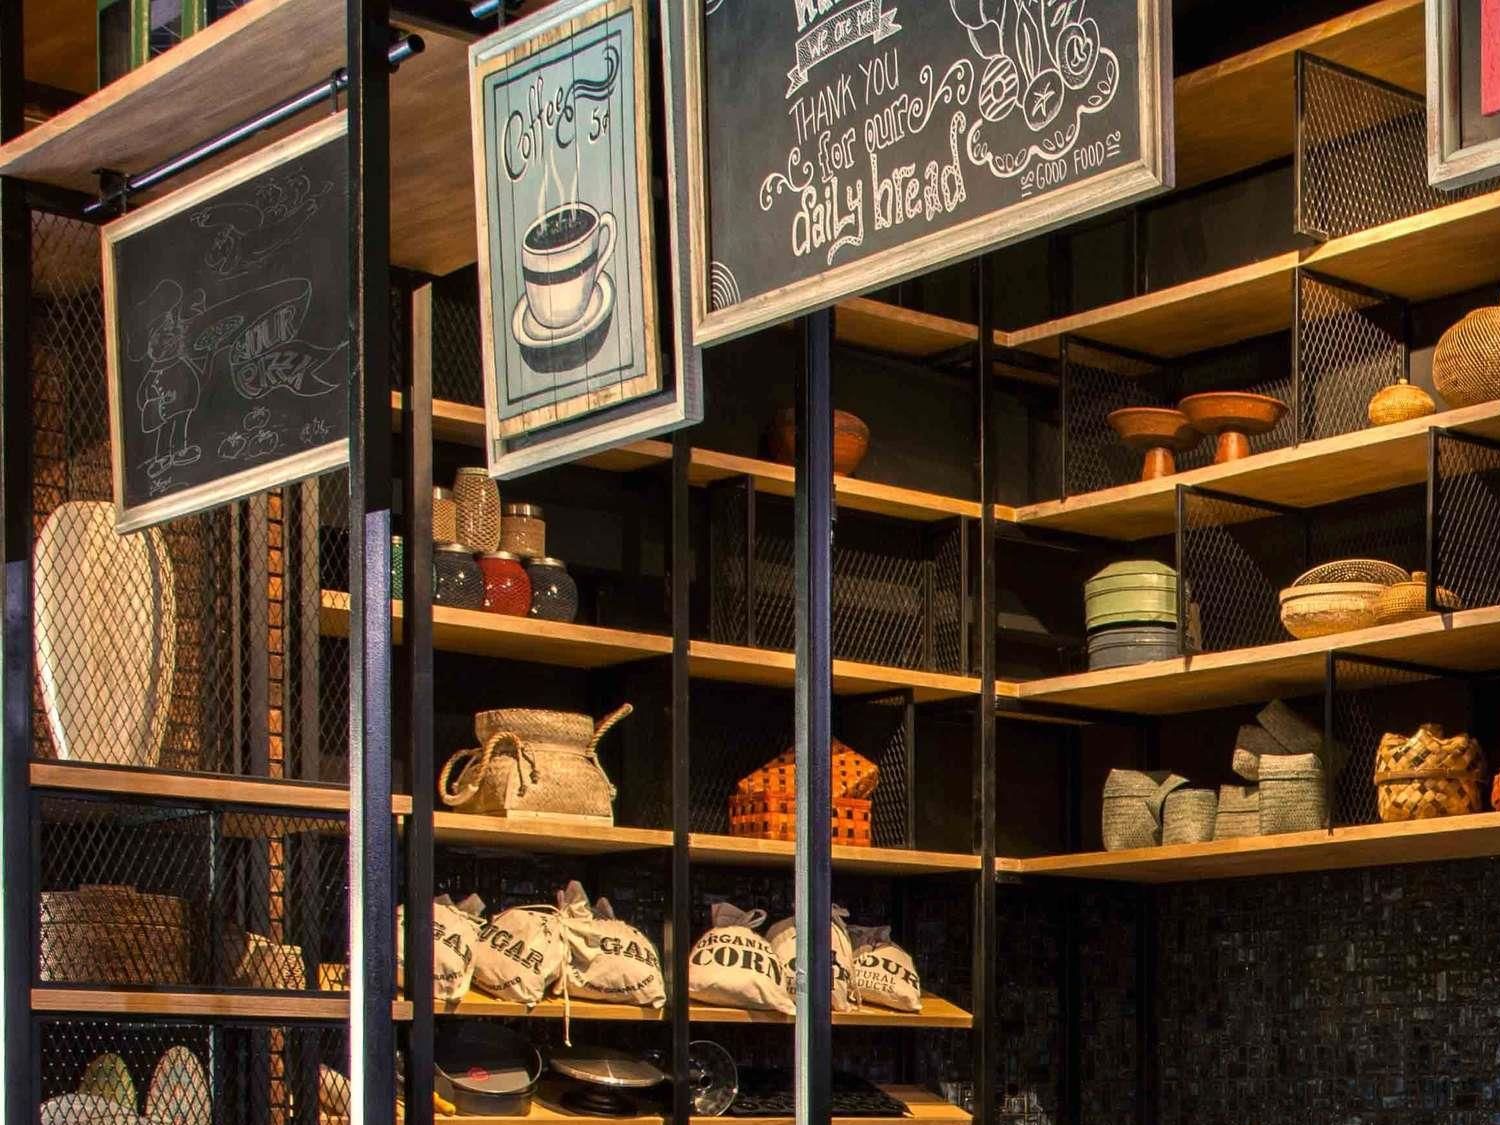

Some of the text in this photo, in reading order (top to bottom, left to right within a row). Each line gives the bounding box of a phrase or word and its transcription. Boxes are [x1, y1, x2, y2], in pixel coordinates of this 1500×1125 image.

[834, 17, 852, 41] are
[789, 47, 899, 144] THANK YOU
[501, 75, 575, 182] Coffee
[819, 94, 908, 183] for our
[870, 110, 967, 231] bread
[1036, 141, 1105, 190] GOOD FOOD
[477, 925, 544, 974] UGAR
[692, 946, 782, 986] CORN
[855, 969, 897, 985] TURAL
